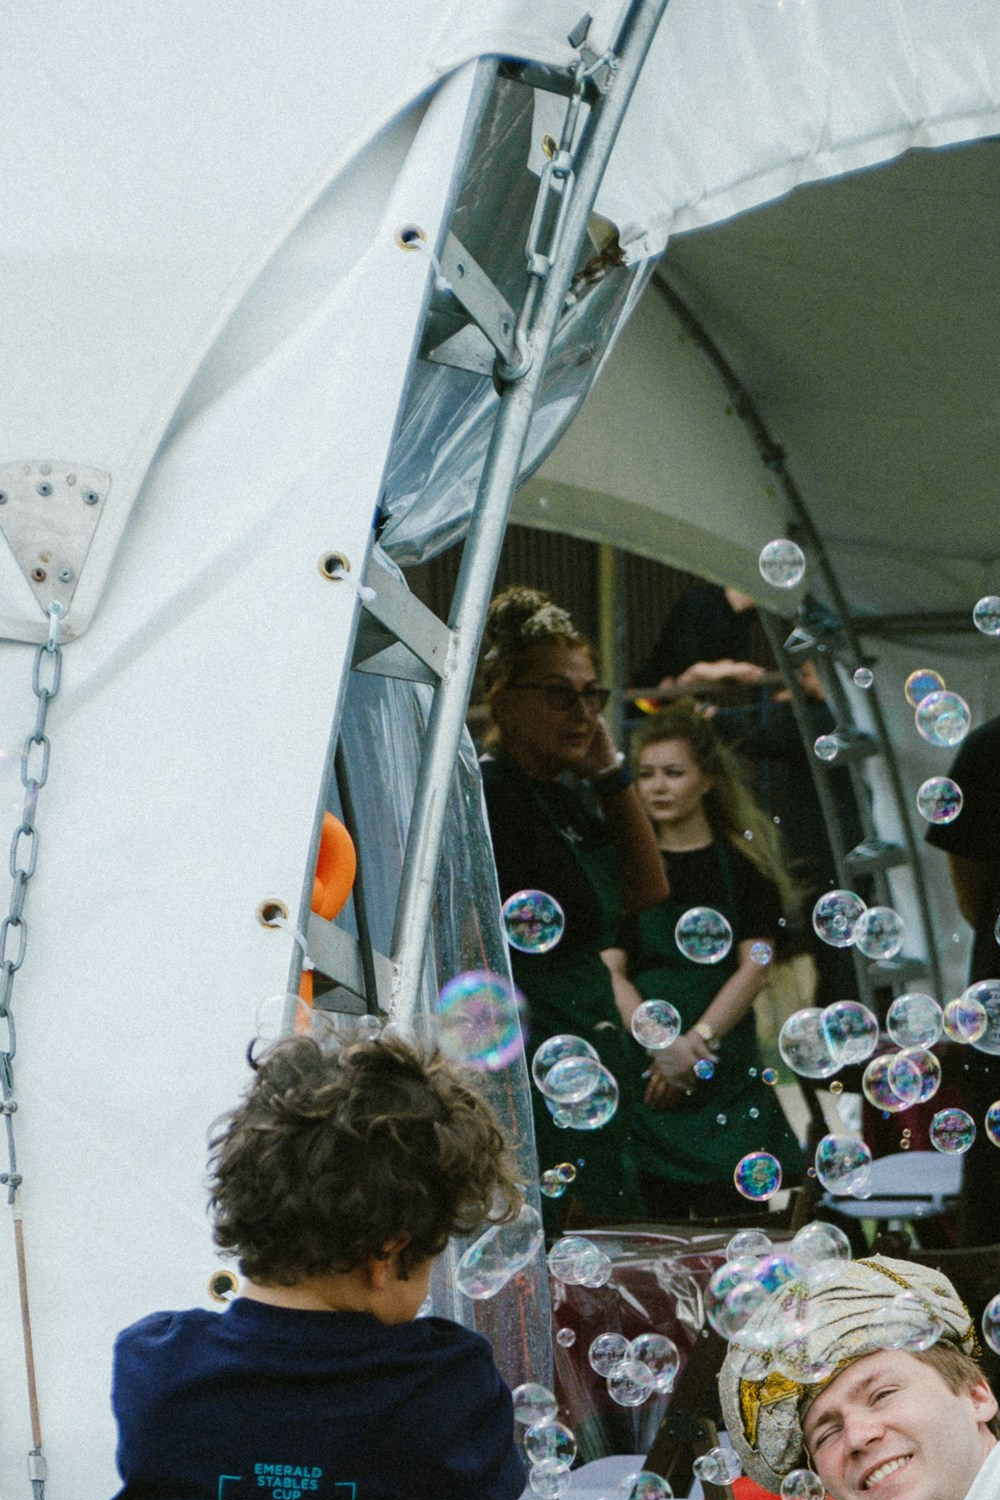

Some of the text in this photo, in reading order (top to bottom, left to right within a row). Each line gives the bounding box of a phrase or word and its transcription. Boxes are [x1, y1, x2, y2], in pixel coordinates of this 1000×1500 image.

[253, 1463, 323, 1478] EMERALD
[257, 1476, 318, 1490] STABLES
[272, 1489, 301, 1500] CUP
